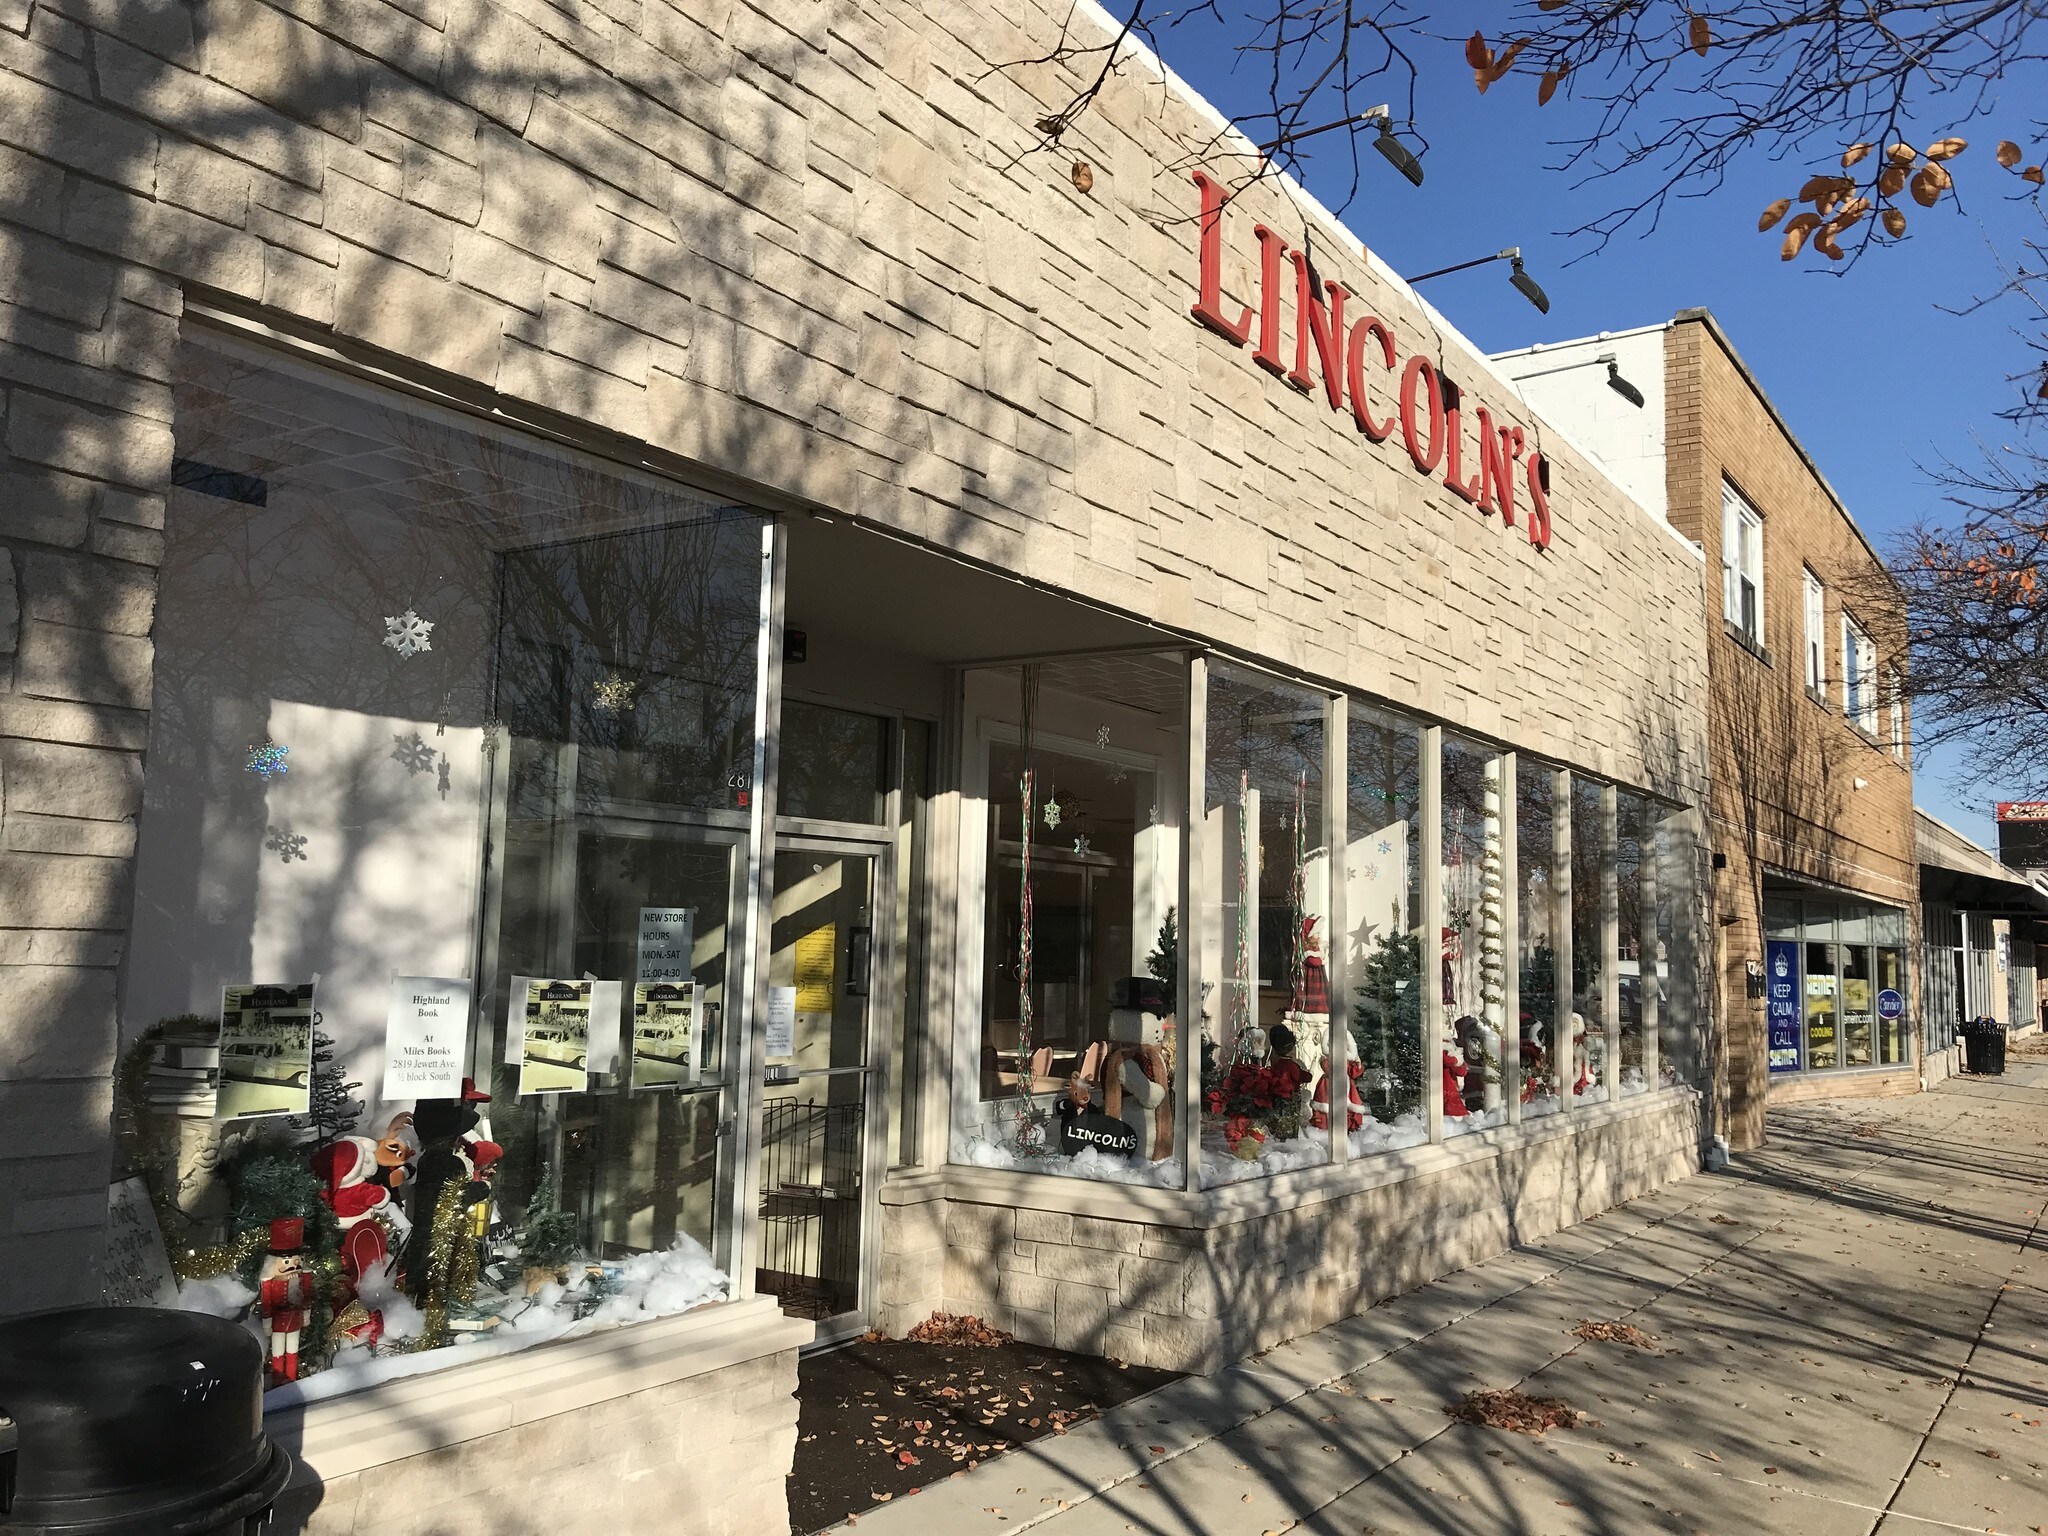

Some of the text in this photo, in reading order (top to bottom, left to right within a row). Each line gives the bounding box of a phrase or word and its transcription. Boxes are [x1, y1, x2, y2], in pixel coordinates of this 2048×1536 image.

[1191, 169, 1552, 552] LINCOLN'S
[644, 913, 688, 922] NEW STORE
[643, 931, 670, 941] HOURS
[642, 950, 681, 960] MON.-SAT
[1773, 983, 1791, 998] KEEP
[412, 995, 450, 1006] Highland
[418, 1008, 439, 1018] Book
[1777, 1018, 1789, 1028] AND
[1810, 1026, 1834, 1038] COOLING
[423, 1034, 434, 1043] At
[1774, 1031, 1793, 1046] CALL
[403, 1046, 451, 1056] Miles Books
[392, 1059, 457, 1069] 2819 Jewett Ave.
[406, 1071, 427, 1081] block
[429, 1071, 451, 1081] South
[1067, 1125, 1137, 1150] LINCOLN'S
